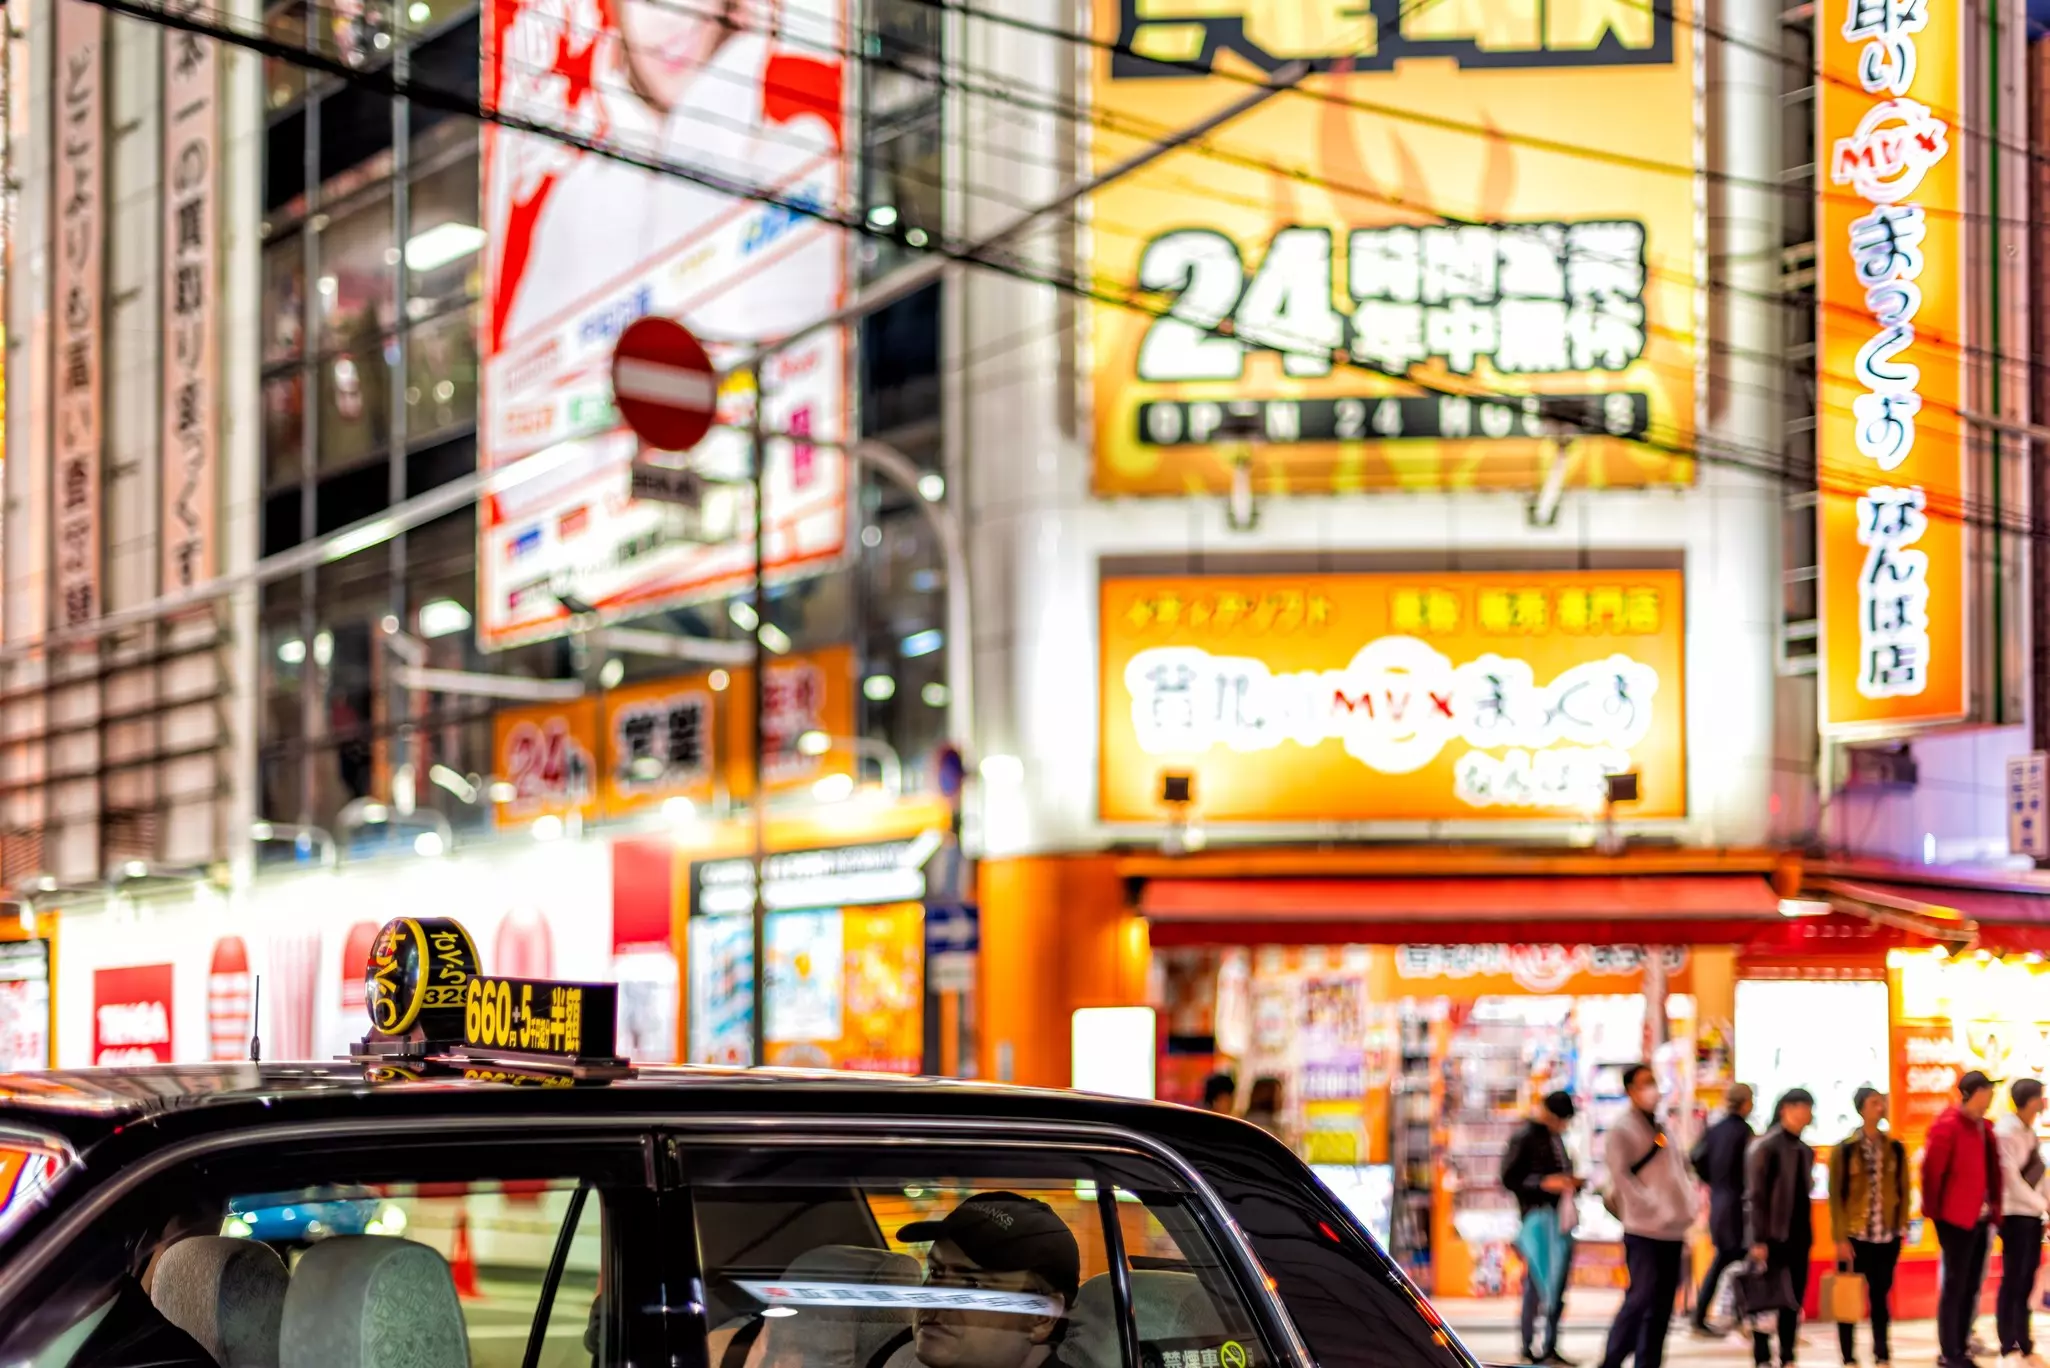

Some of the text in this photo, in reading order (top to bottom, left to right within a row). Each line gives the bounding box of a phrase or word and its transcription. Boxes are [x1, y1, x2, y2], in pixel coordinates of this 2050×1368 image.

[1138, 226, 1343, 381] 24
[1334, 396, 1404, 439] 24
[1438, 392, 1635, 438] HOUS
